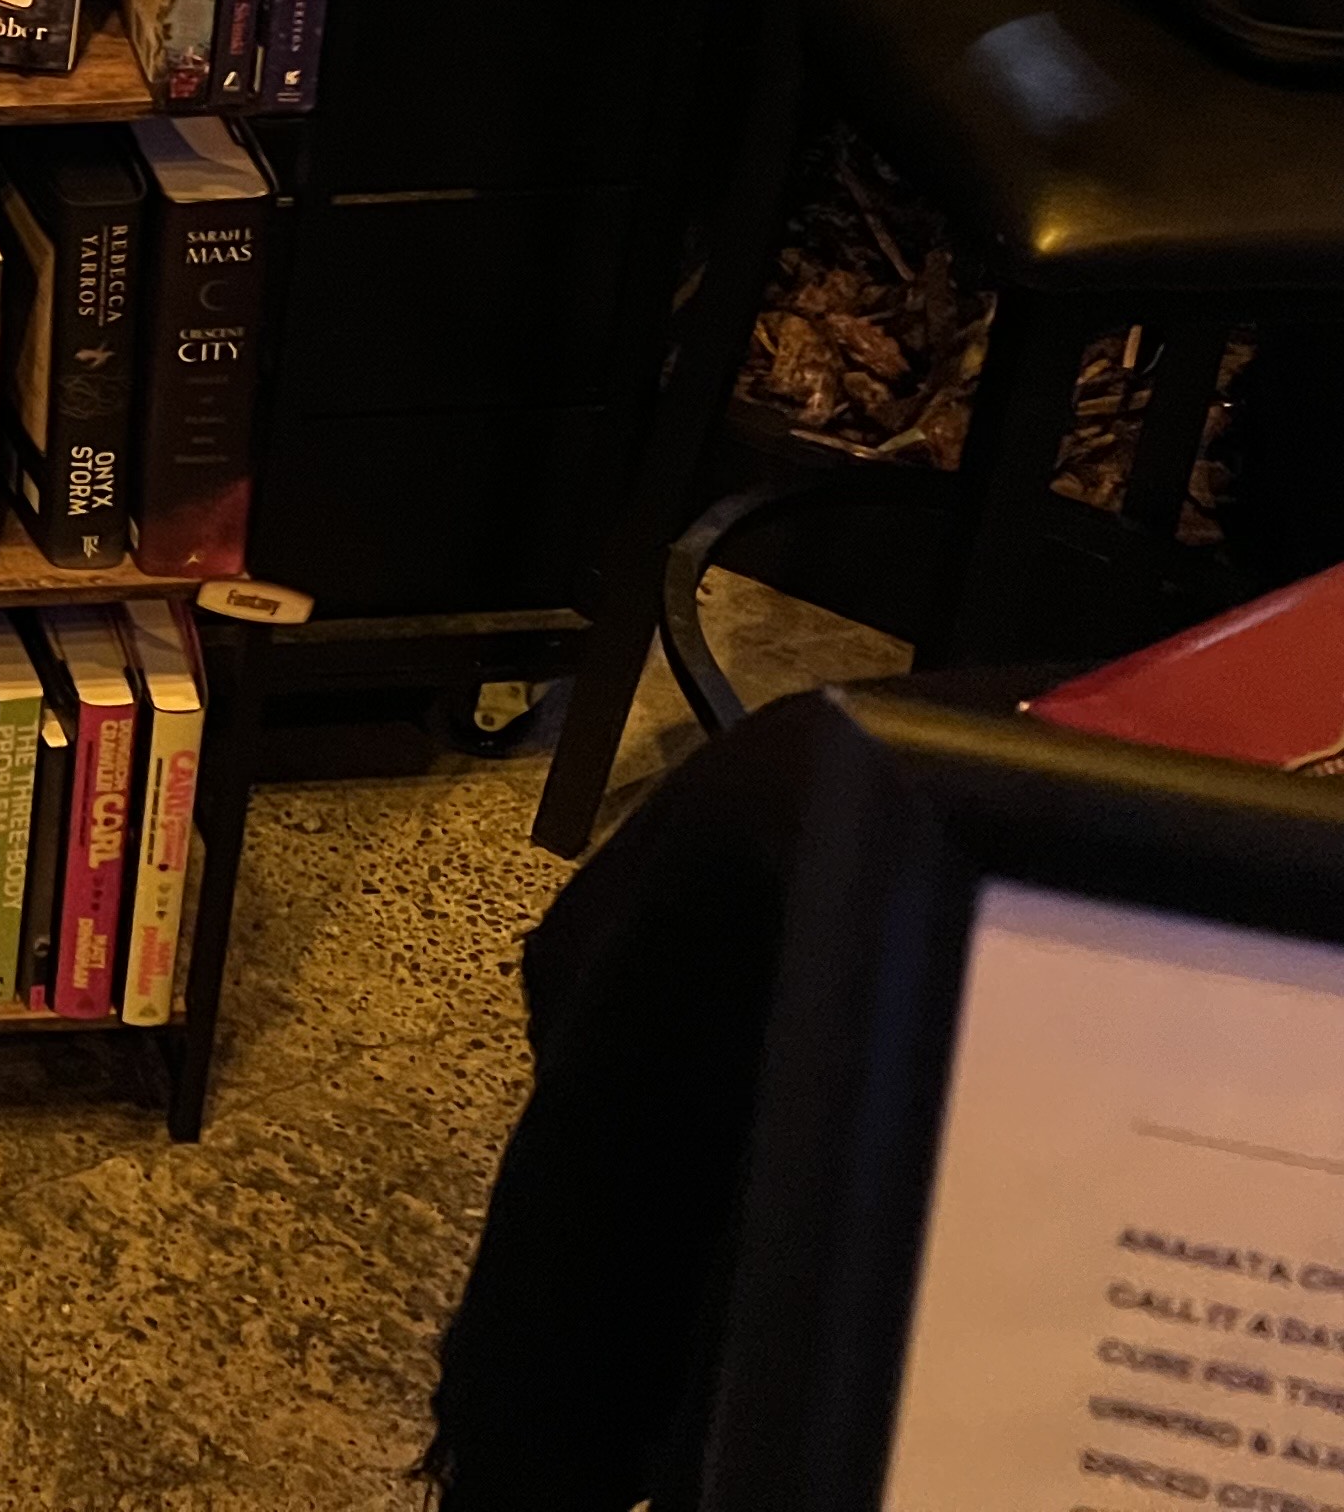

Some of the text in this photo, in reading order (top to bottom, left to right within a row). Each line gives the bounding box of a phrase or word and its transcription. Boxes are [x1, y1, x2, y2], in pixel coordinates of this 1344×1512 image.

[78, 234, 100, 317] YARROS
[107, 224, 129, 323] REBECCA
[186, 244, 252, 265] MAAS
[177, 342, 241, 364] CITY
[68, 445, 93, 517] STORM
[92, 451, 115, 510] ONYX
[1, 720, 38, 910] THE THREE-BODY
